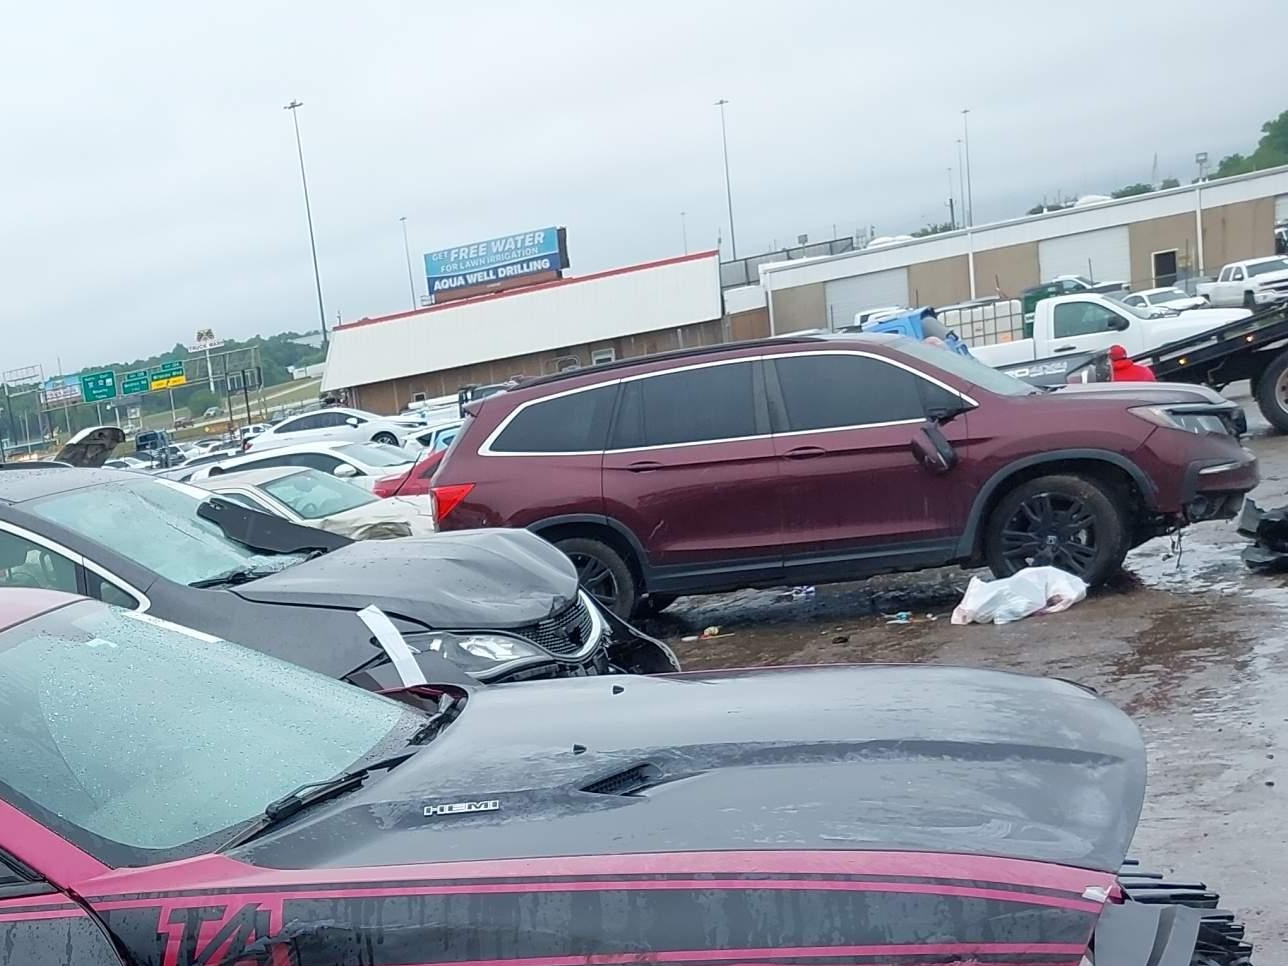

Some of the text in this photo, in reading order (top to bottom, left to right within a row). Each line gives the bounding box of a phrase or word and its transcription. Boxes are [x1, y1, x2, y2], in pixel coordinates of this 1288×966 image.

[431, 232, 545, 263] GET FREE WATER
[440, 247, 539, 274] FOR LAWN IRRIGATION
[433, 259, 550, 291] AQUA WELL DRILLING
[423, 800, 500, 816] HEMI
